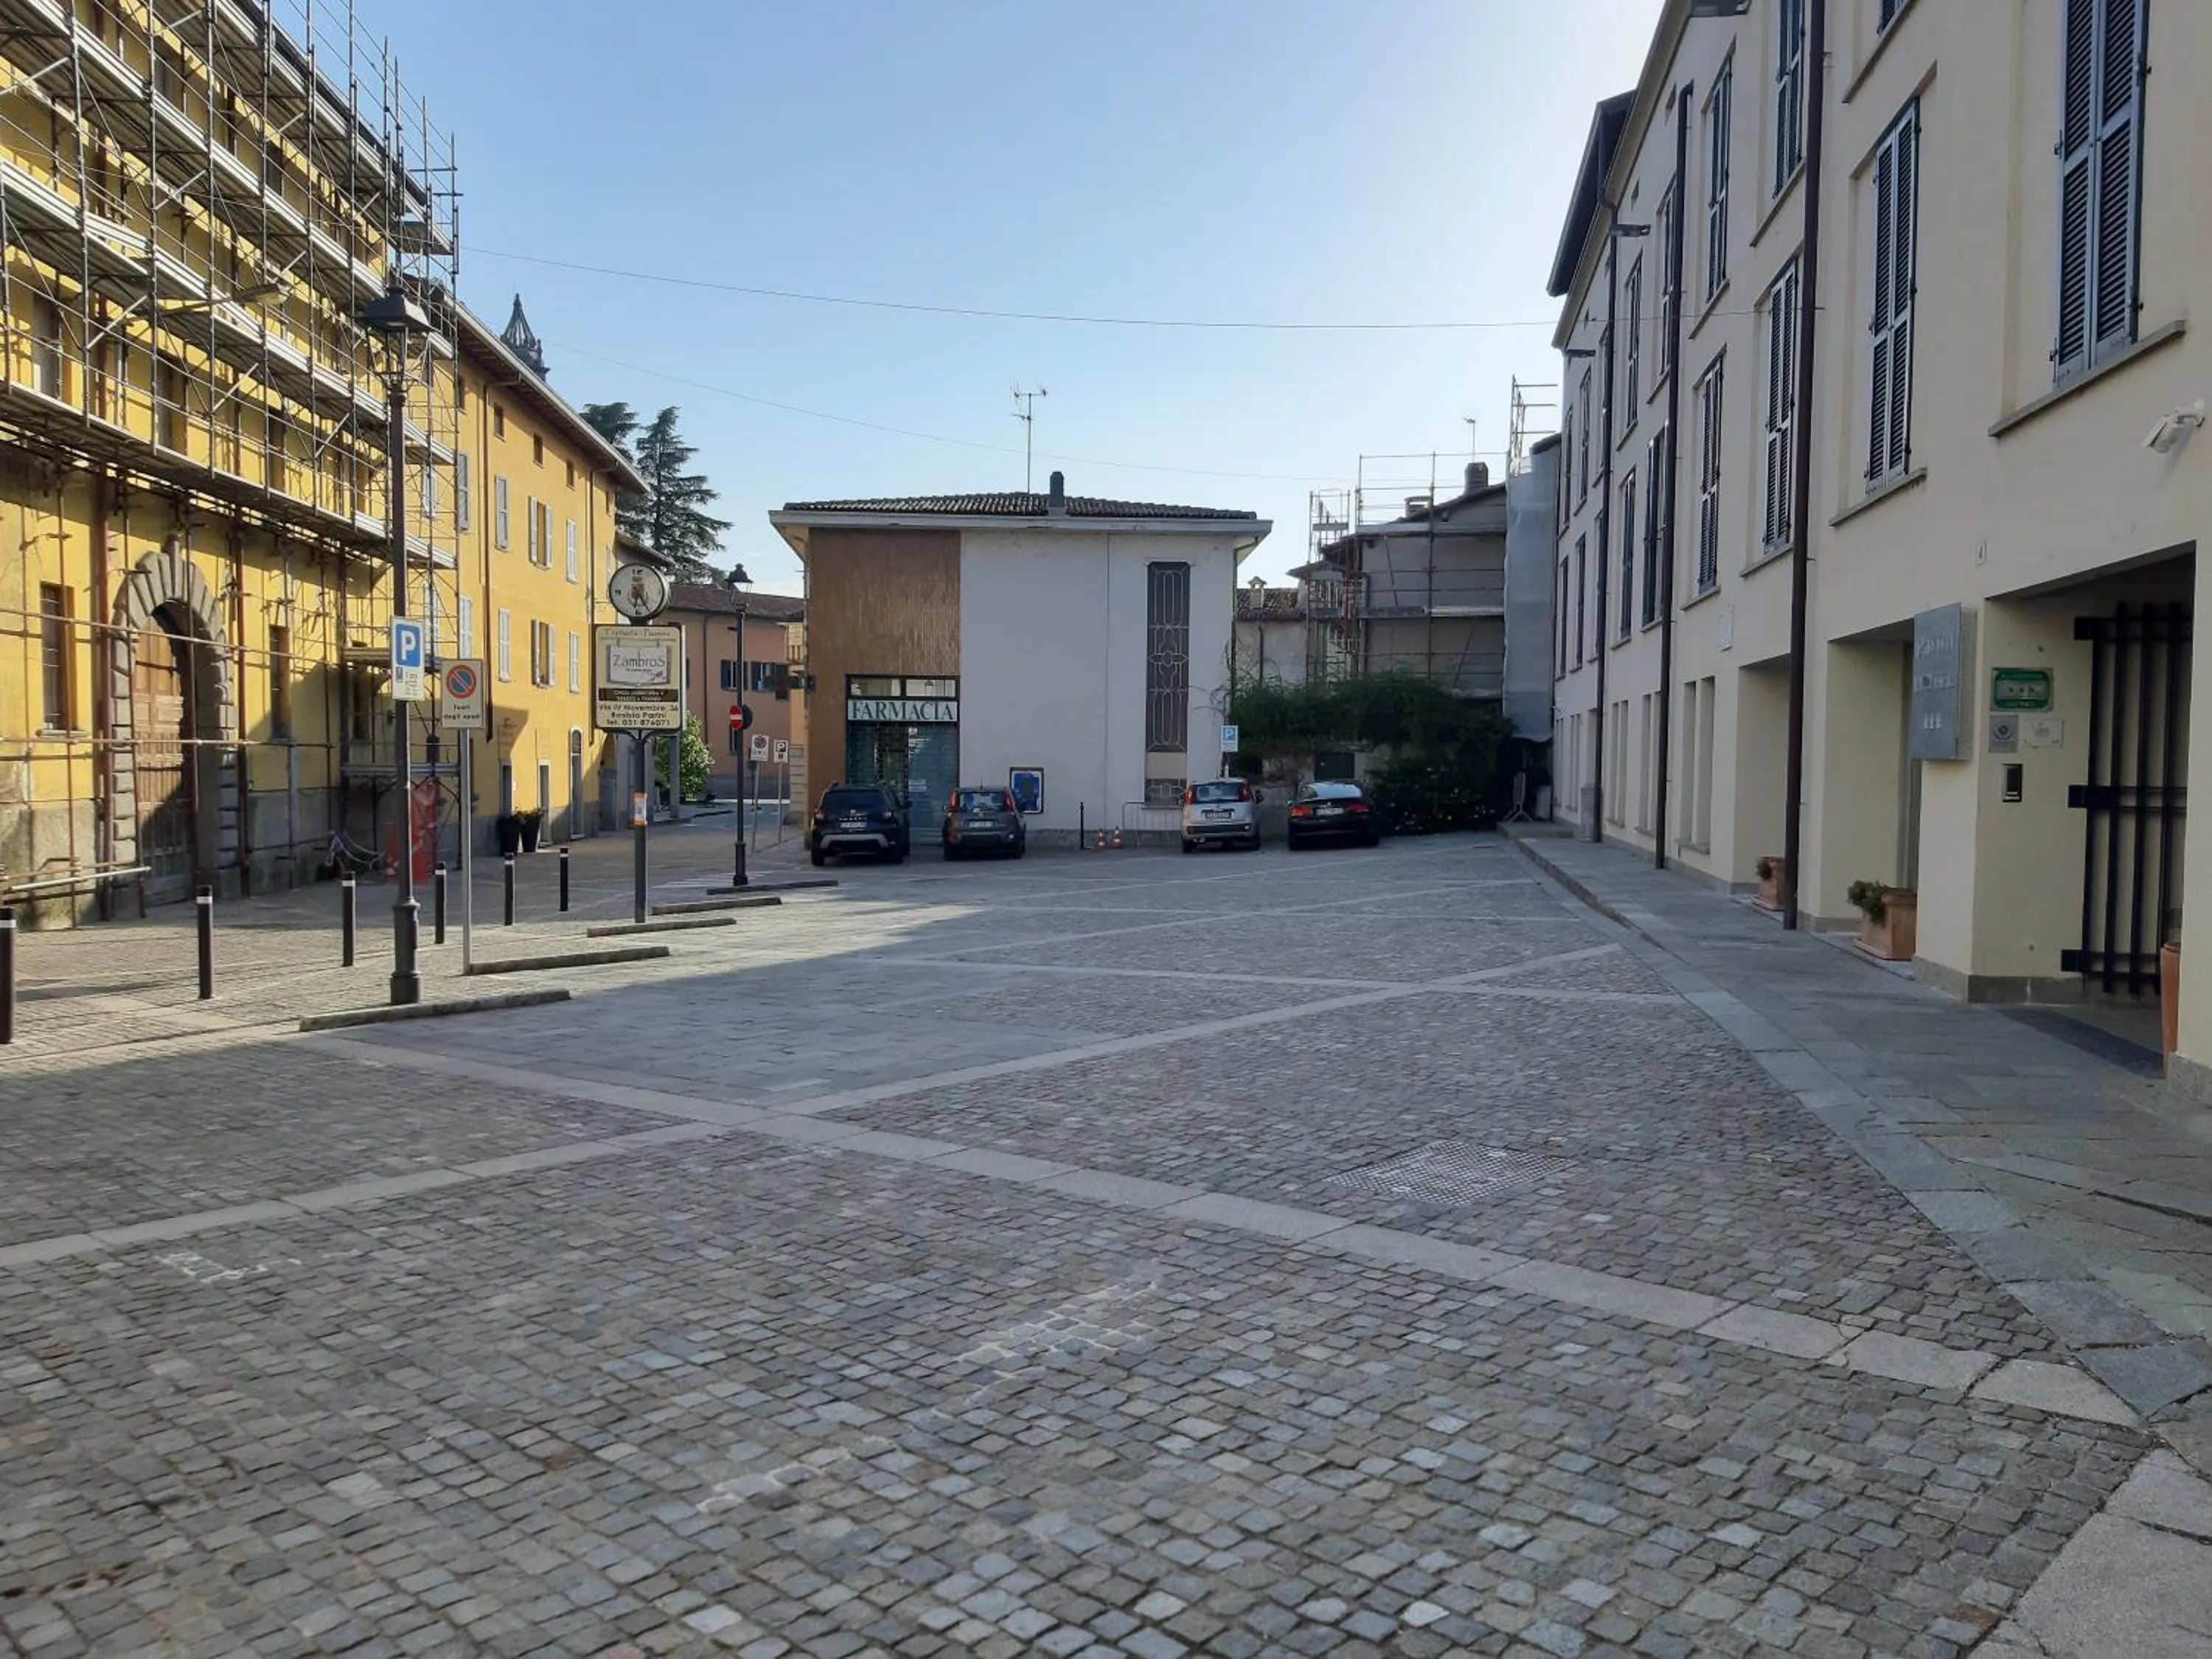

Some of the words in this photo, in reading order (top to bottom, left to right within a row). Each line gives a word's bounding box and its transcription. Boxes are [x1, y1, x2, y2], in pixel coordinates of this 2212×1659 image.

[400, 629, 417, 661] P
[852, 700, 954, 720] FARMACIA
[1225, 728, 1235, 739] P
